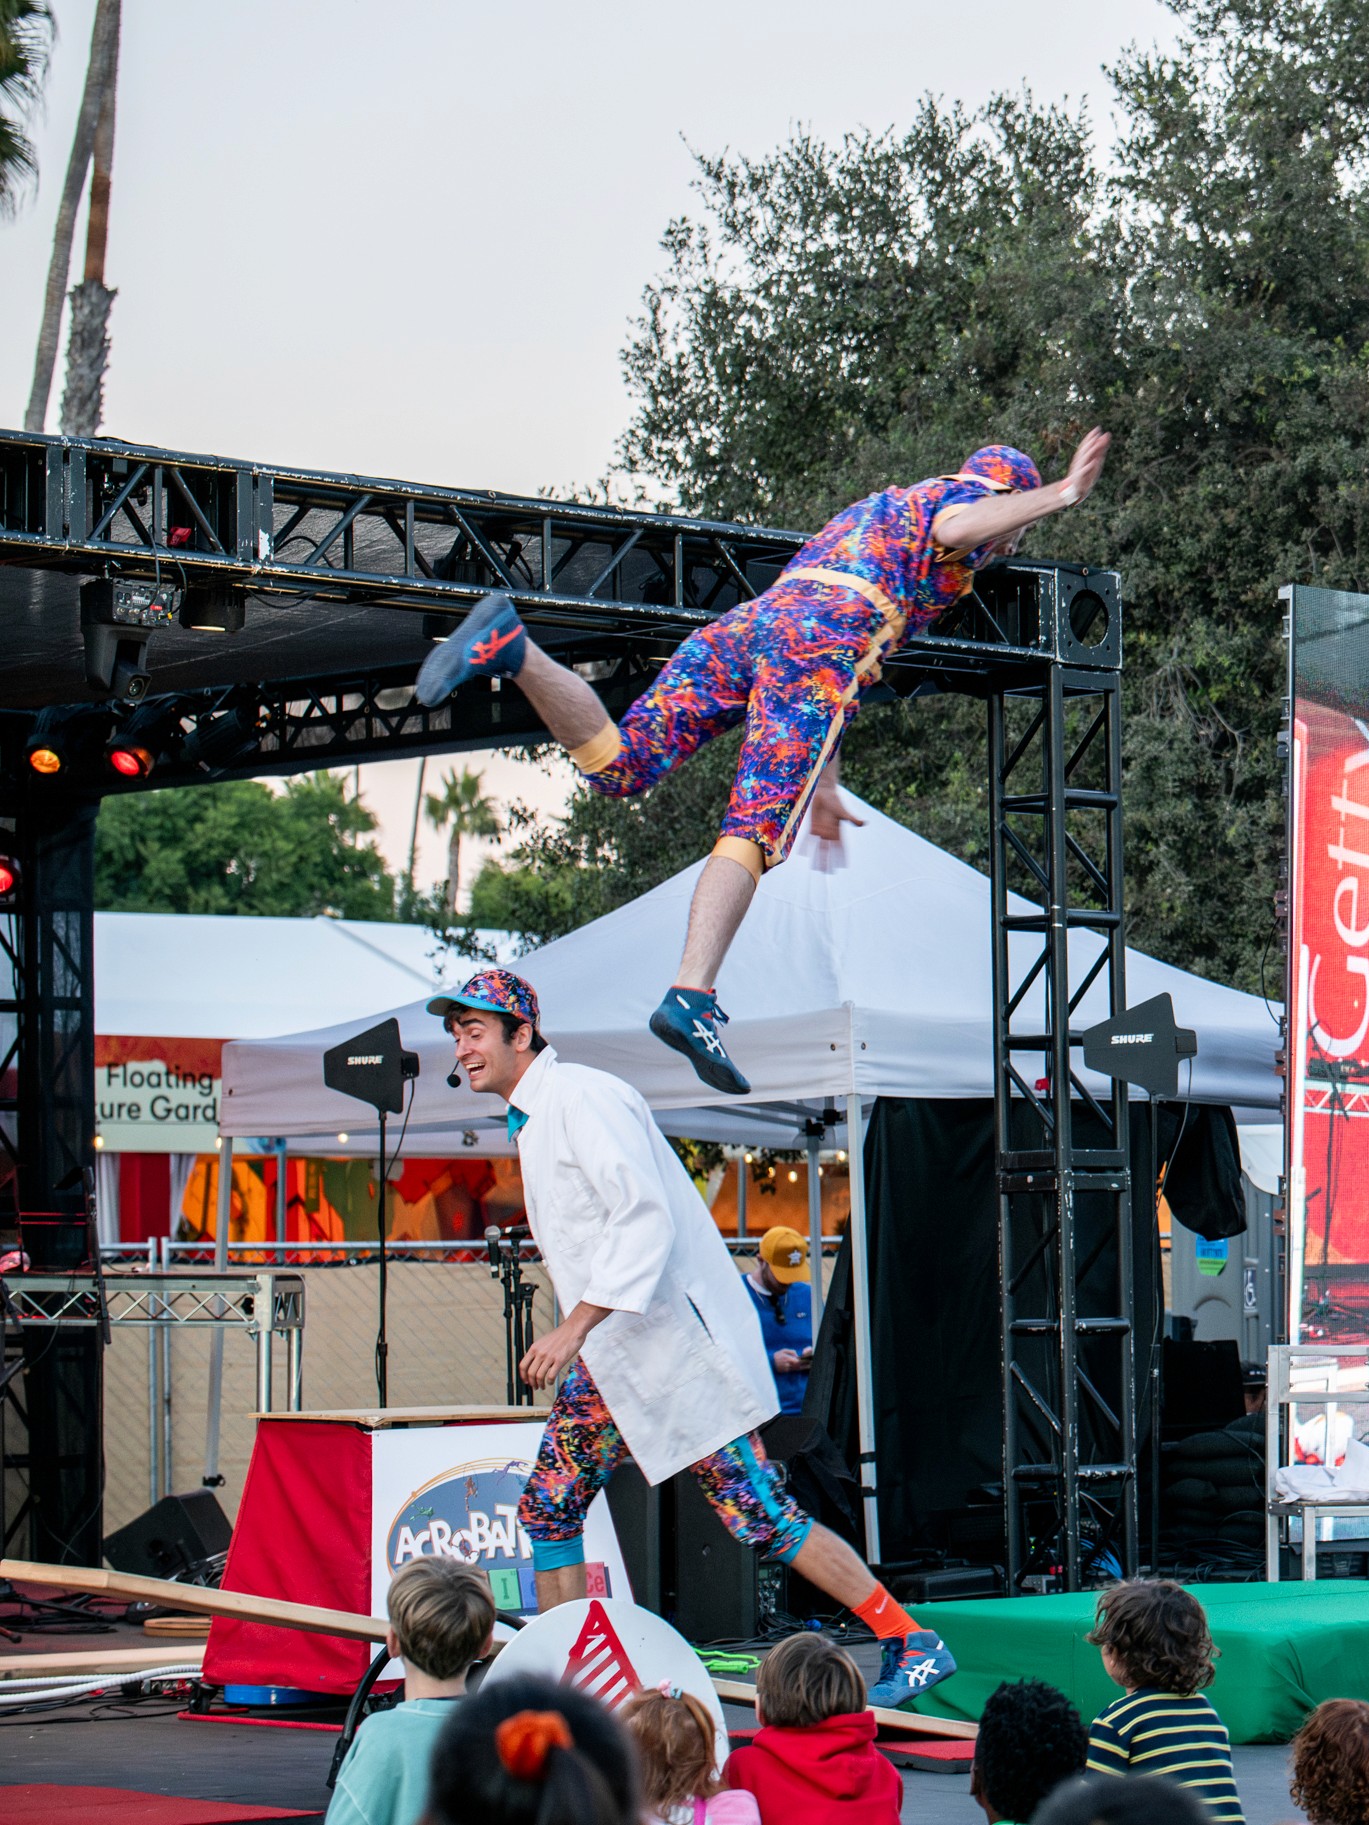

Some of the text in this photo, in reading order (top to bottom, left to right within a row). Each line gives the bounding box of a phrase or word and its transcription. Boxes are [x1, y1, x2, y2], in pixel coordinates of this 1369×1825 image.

[1111, 1033, 1154, 1044] SHURE
[347, 1055, 384, 1065] SHURE
[107, 1062, 213, 1097] Floating
[97, 1102, 141, 1120] ure
